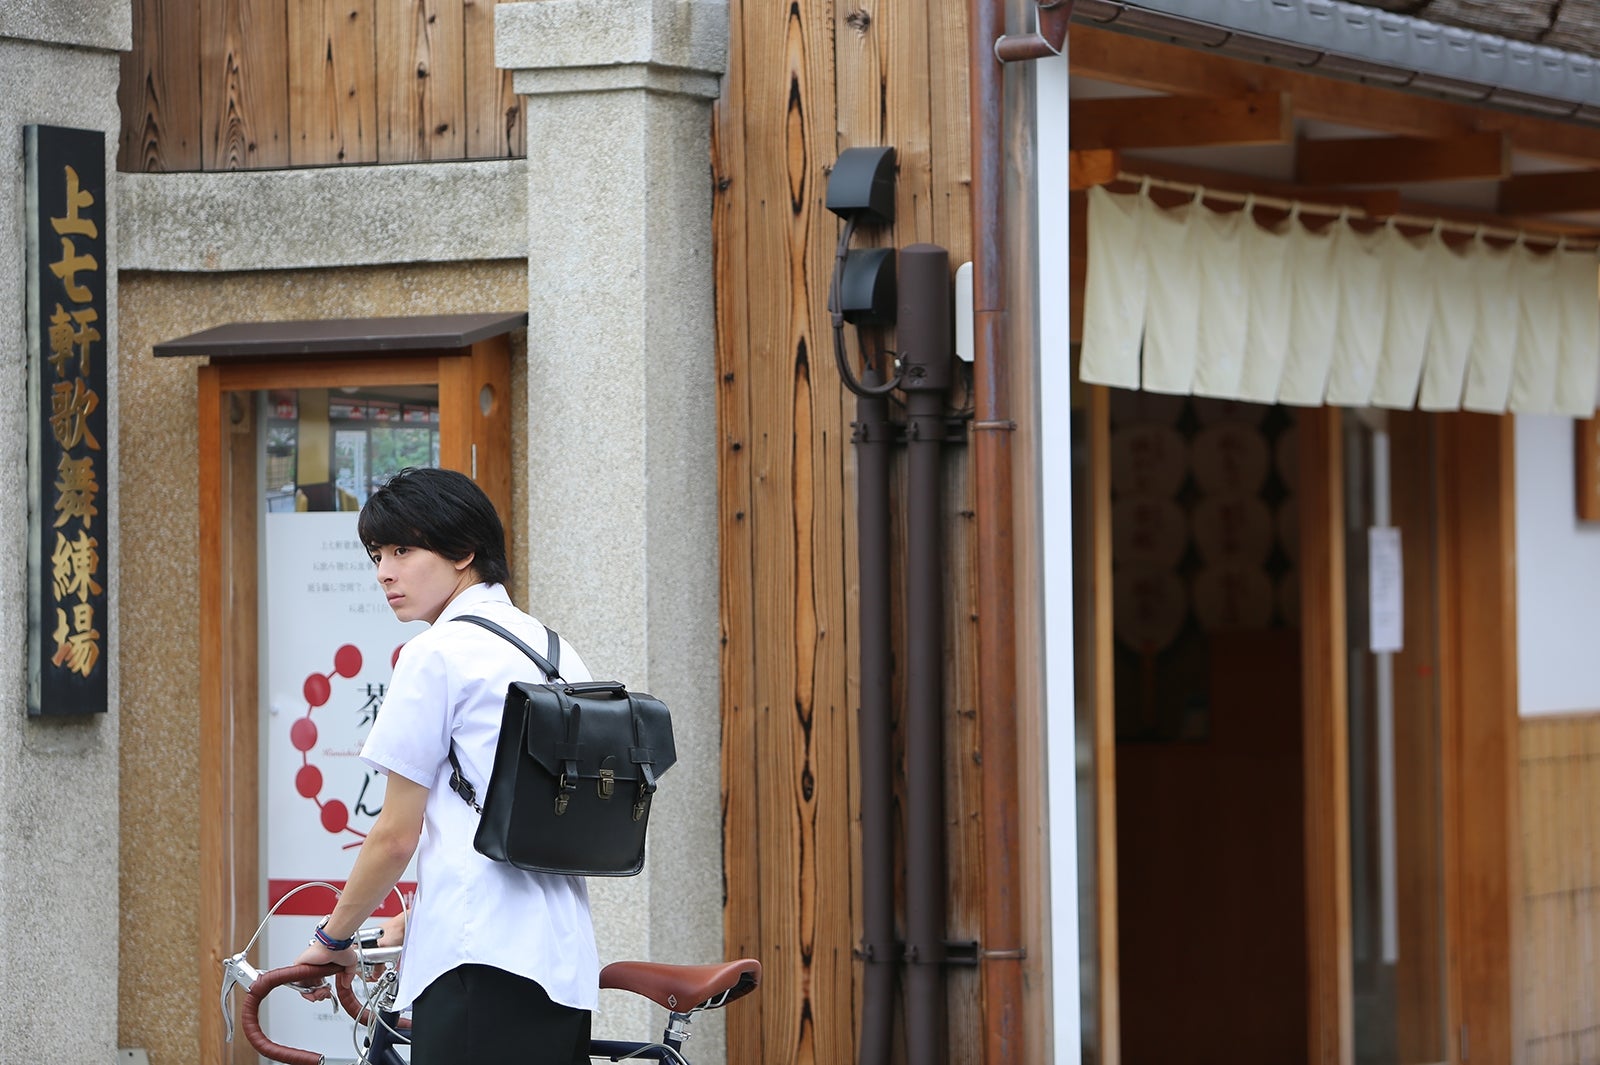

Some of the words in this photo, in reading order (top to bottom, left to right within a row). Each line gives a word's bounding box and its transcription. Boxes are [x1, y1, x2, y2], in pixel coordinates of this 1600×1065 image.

[48, 165, 102, 678] 上七軒歌舞練場
